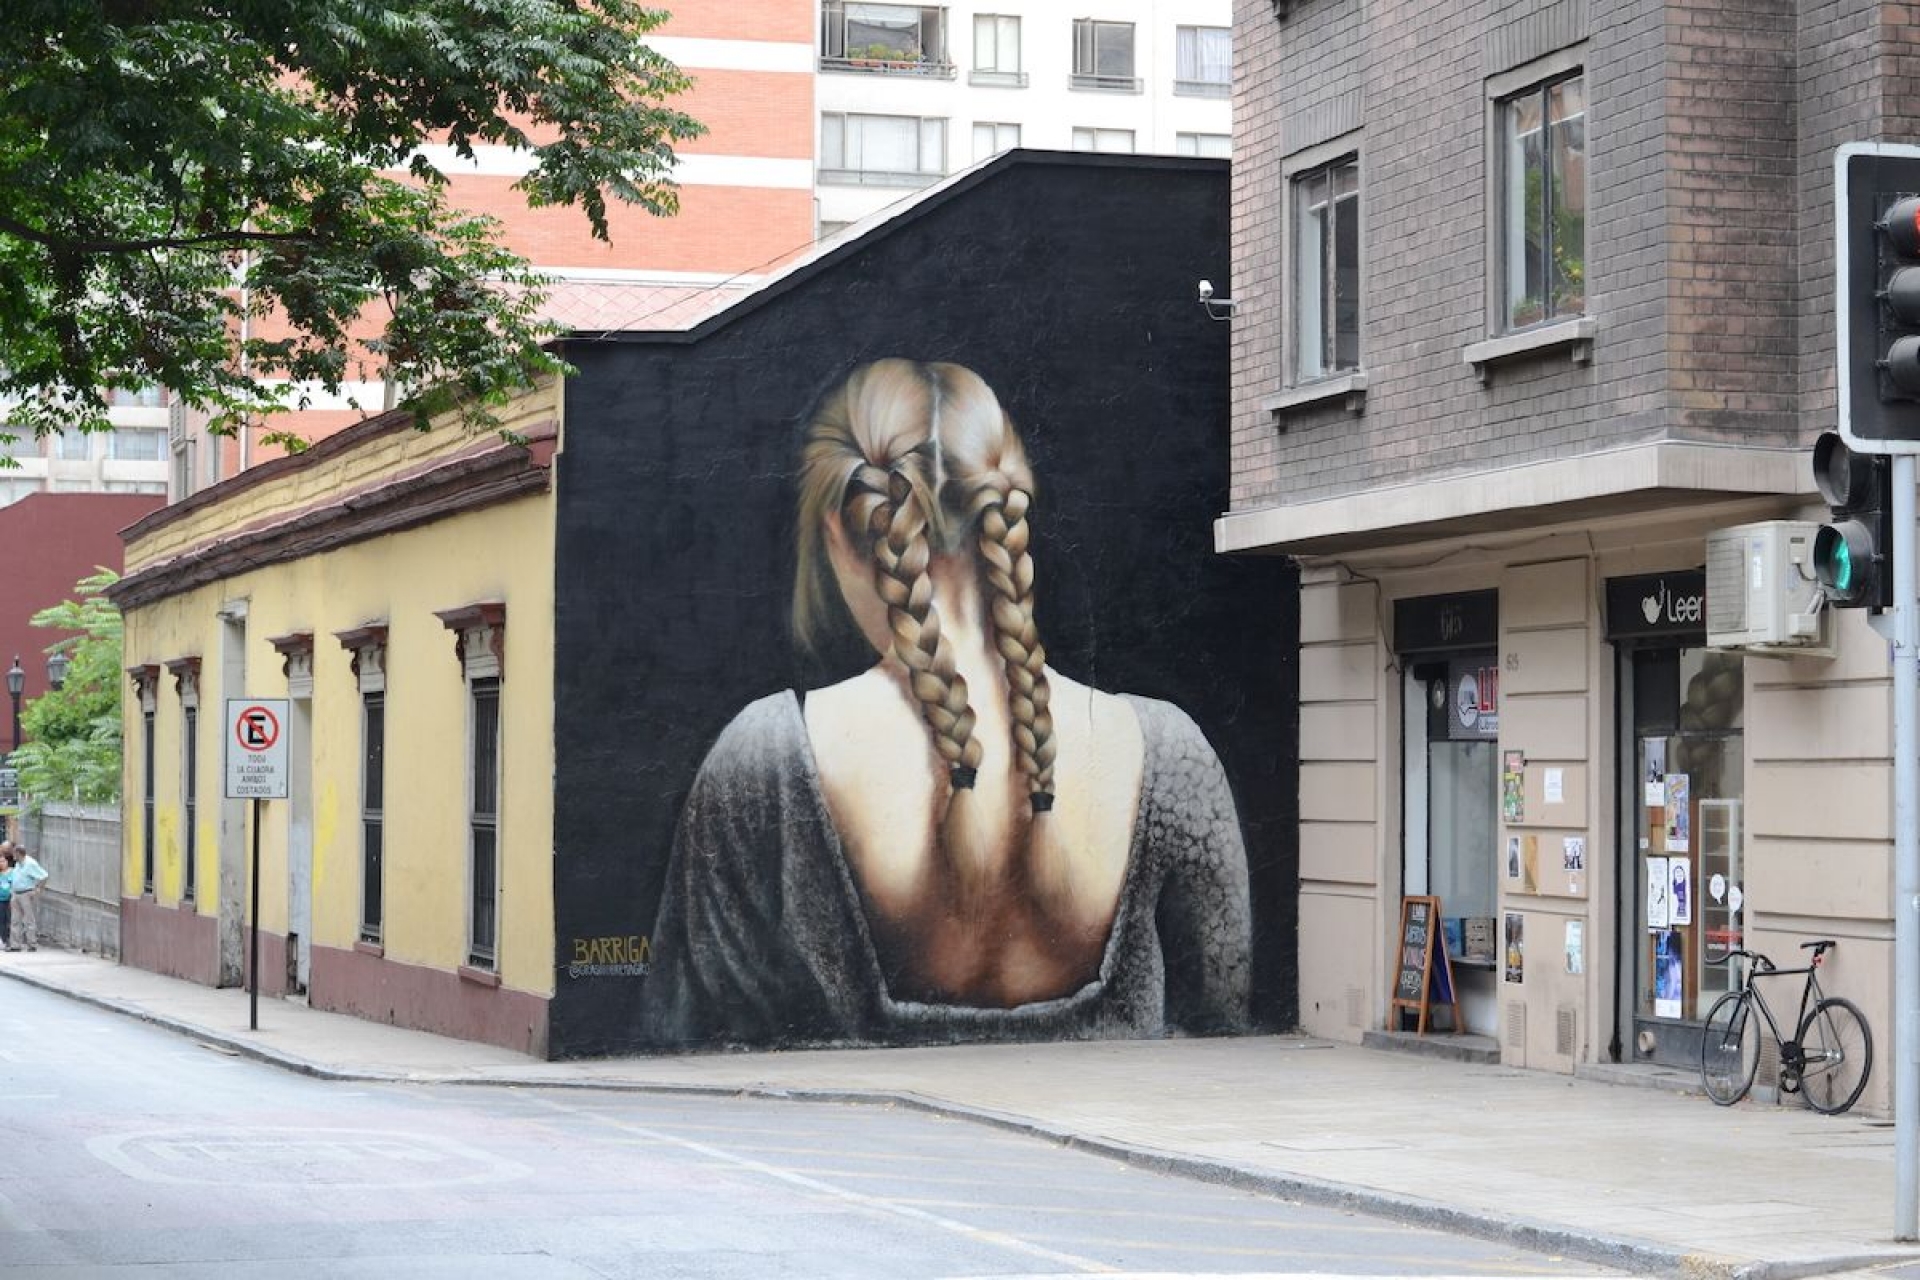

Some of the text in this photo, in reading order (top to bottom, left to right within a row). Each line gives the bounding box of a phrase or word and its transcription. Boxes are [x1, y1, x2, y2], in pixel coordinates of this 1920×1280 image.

[1666, 589, 1703, 622] Leer
[246, 765, 274, 773] CUADRA
[237, 785, 271, 794] COSTADOS
[571, 936, 652, 964] BARRIGA
